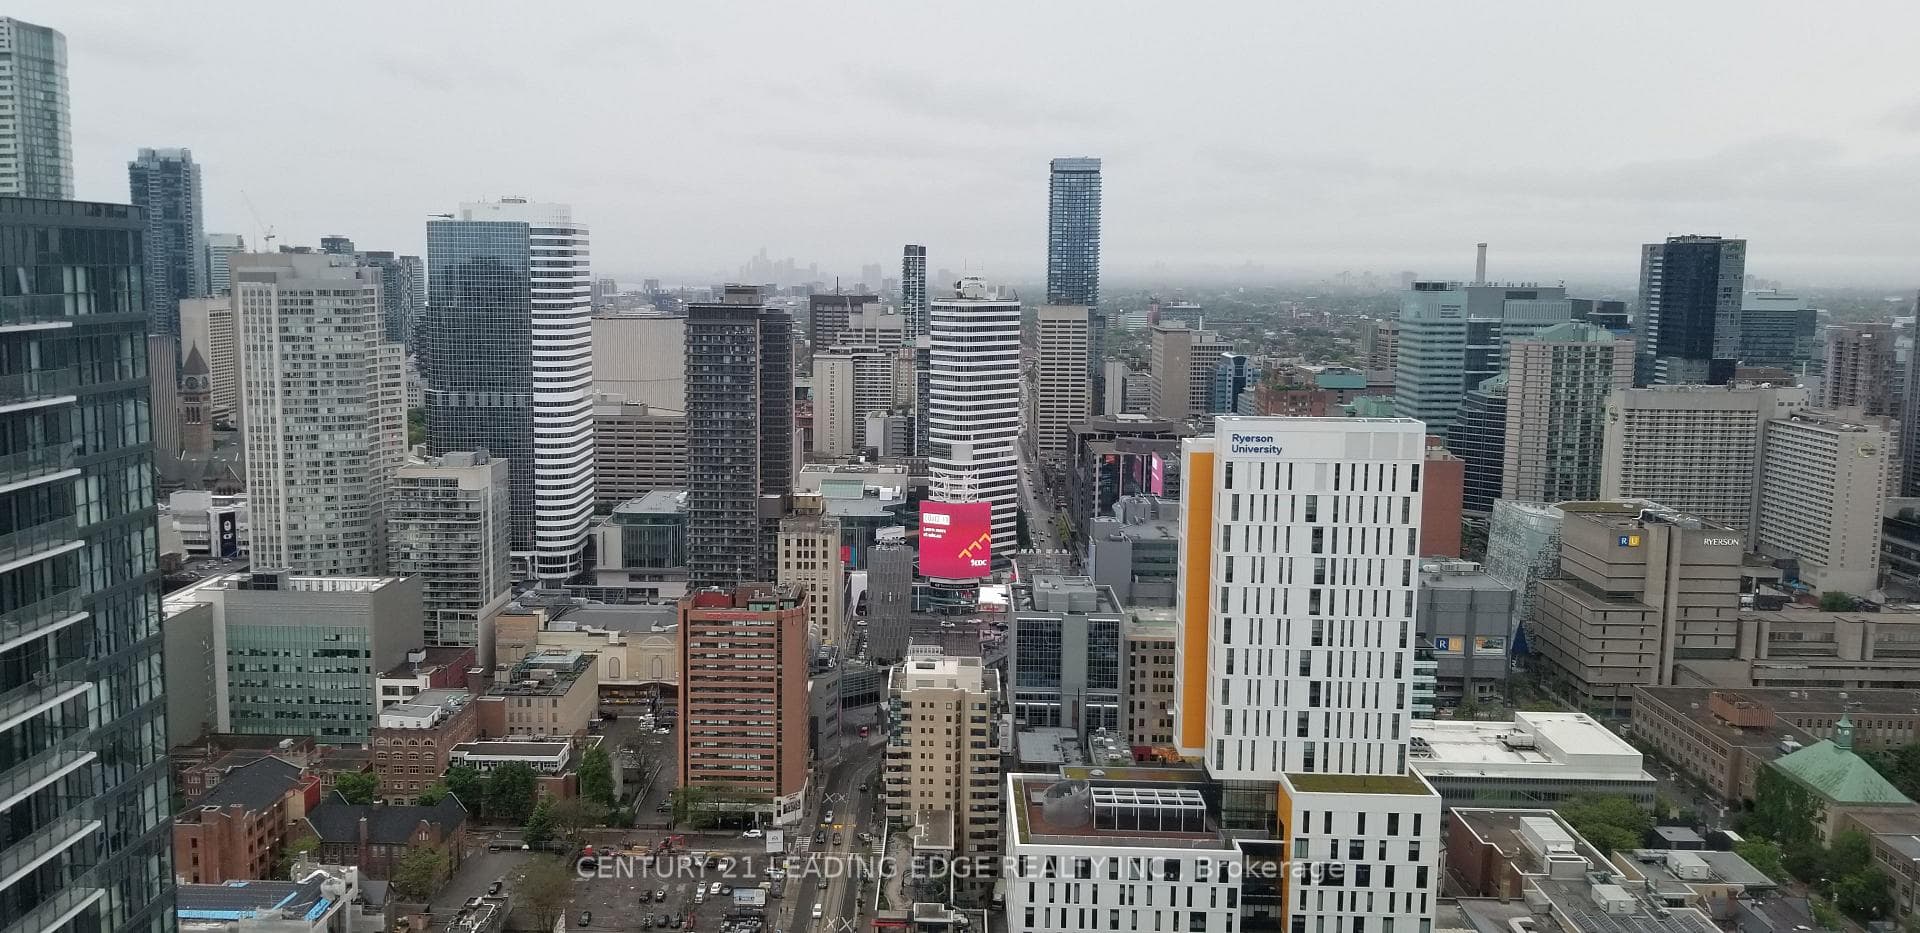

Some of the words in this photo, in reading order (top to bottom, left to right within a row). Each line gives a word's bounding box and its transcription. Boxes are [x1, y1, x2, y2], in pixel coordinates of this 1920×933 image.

[1232, 433, 1273, 443] Ryerson
[1232, 444, 1282, 455] University
[1704, 538, 1739, 546] RYERSON
